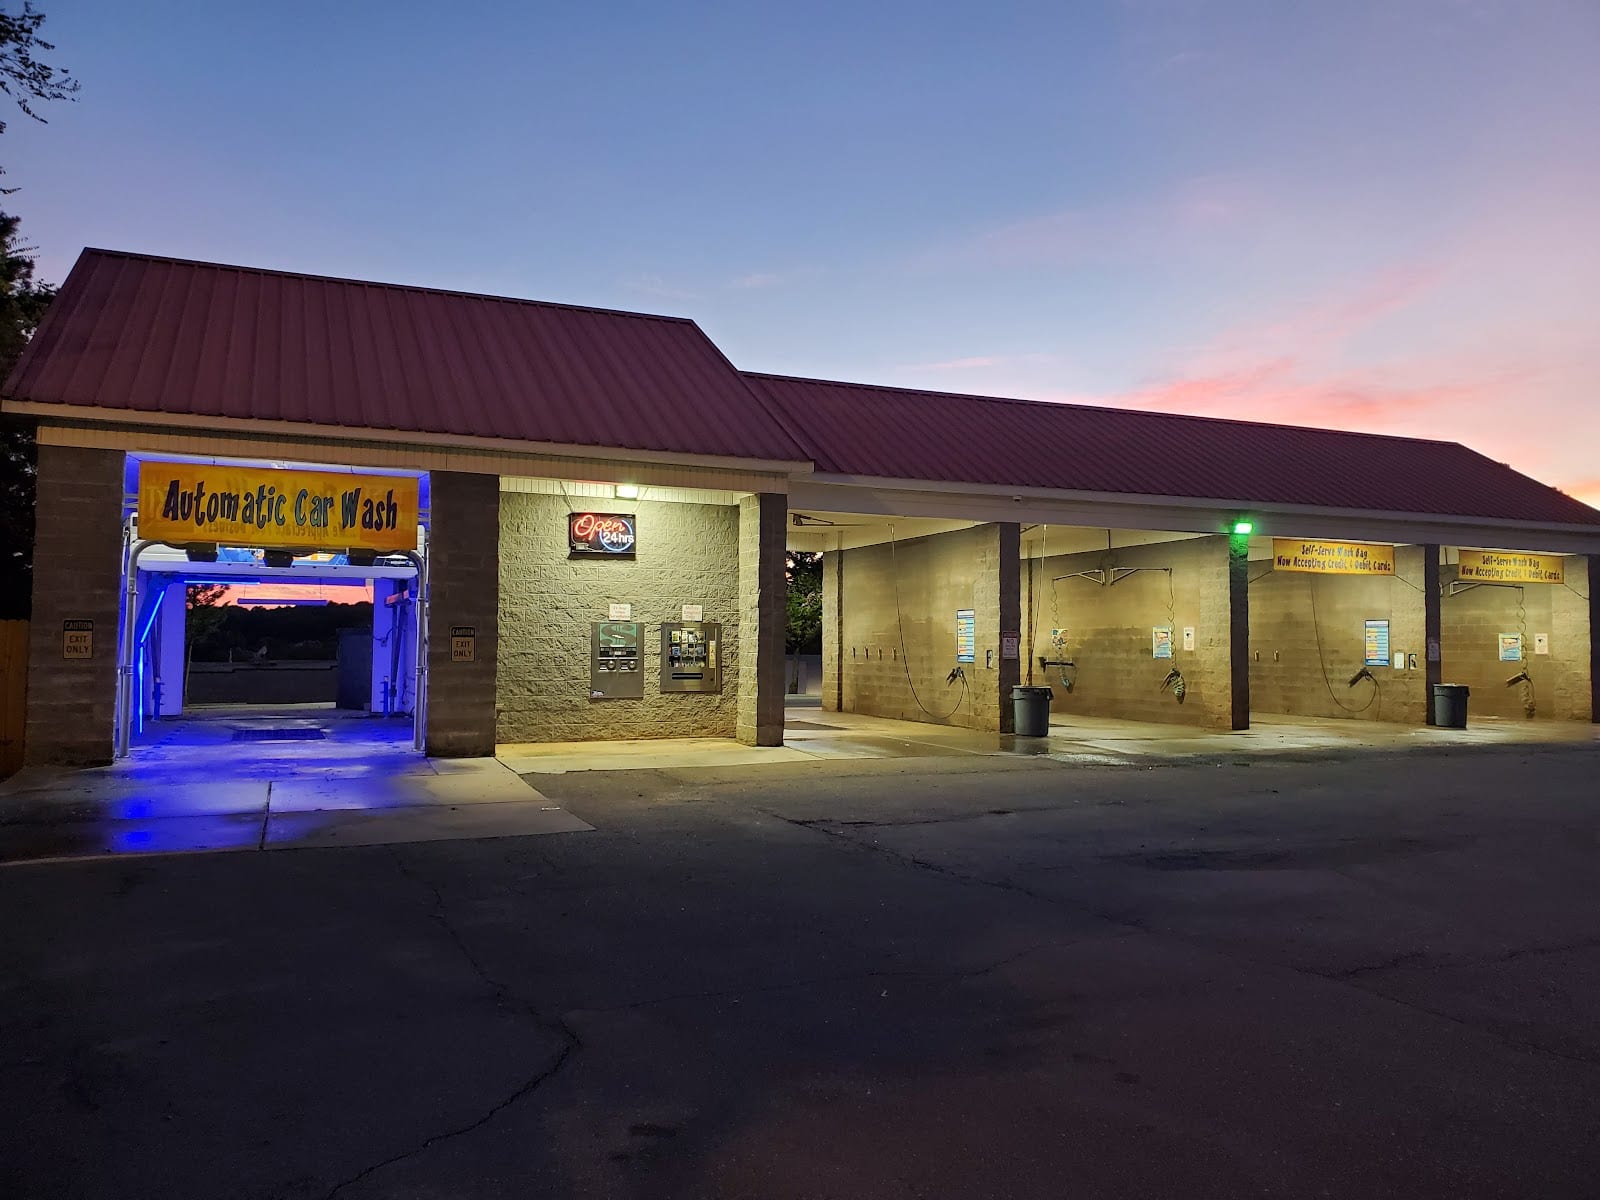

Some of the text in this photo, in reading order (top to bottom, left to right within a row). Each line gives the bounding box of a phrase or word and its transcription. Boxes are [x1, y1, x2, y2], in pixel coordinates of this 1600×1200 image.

[162, 479, 398, 531] Automatic Car Wash
[575, 514, 625, 541] Open
[1301, 544, 1335, 556] Self-Serve
[1355, 547, 1368, 559] Bay
[1277, 555, 1291, 567] Now
[1293, 556, 1326, 570] Accepting
[1328, 559, 1348, 570] Credit
[1355, 560, 1371, 571] Debit
[1373, 560, 1391, 571] Cards
[1461, 565, 1473, 576] Now
[1475, 566, 1504, 579] Accepting
[70, 635, 88, 643] EXIT
[456, 640, 471, 648] EXIT
[66, 645, 89, 654] ONLY
